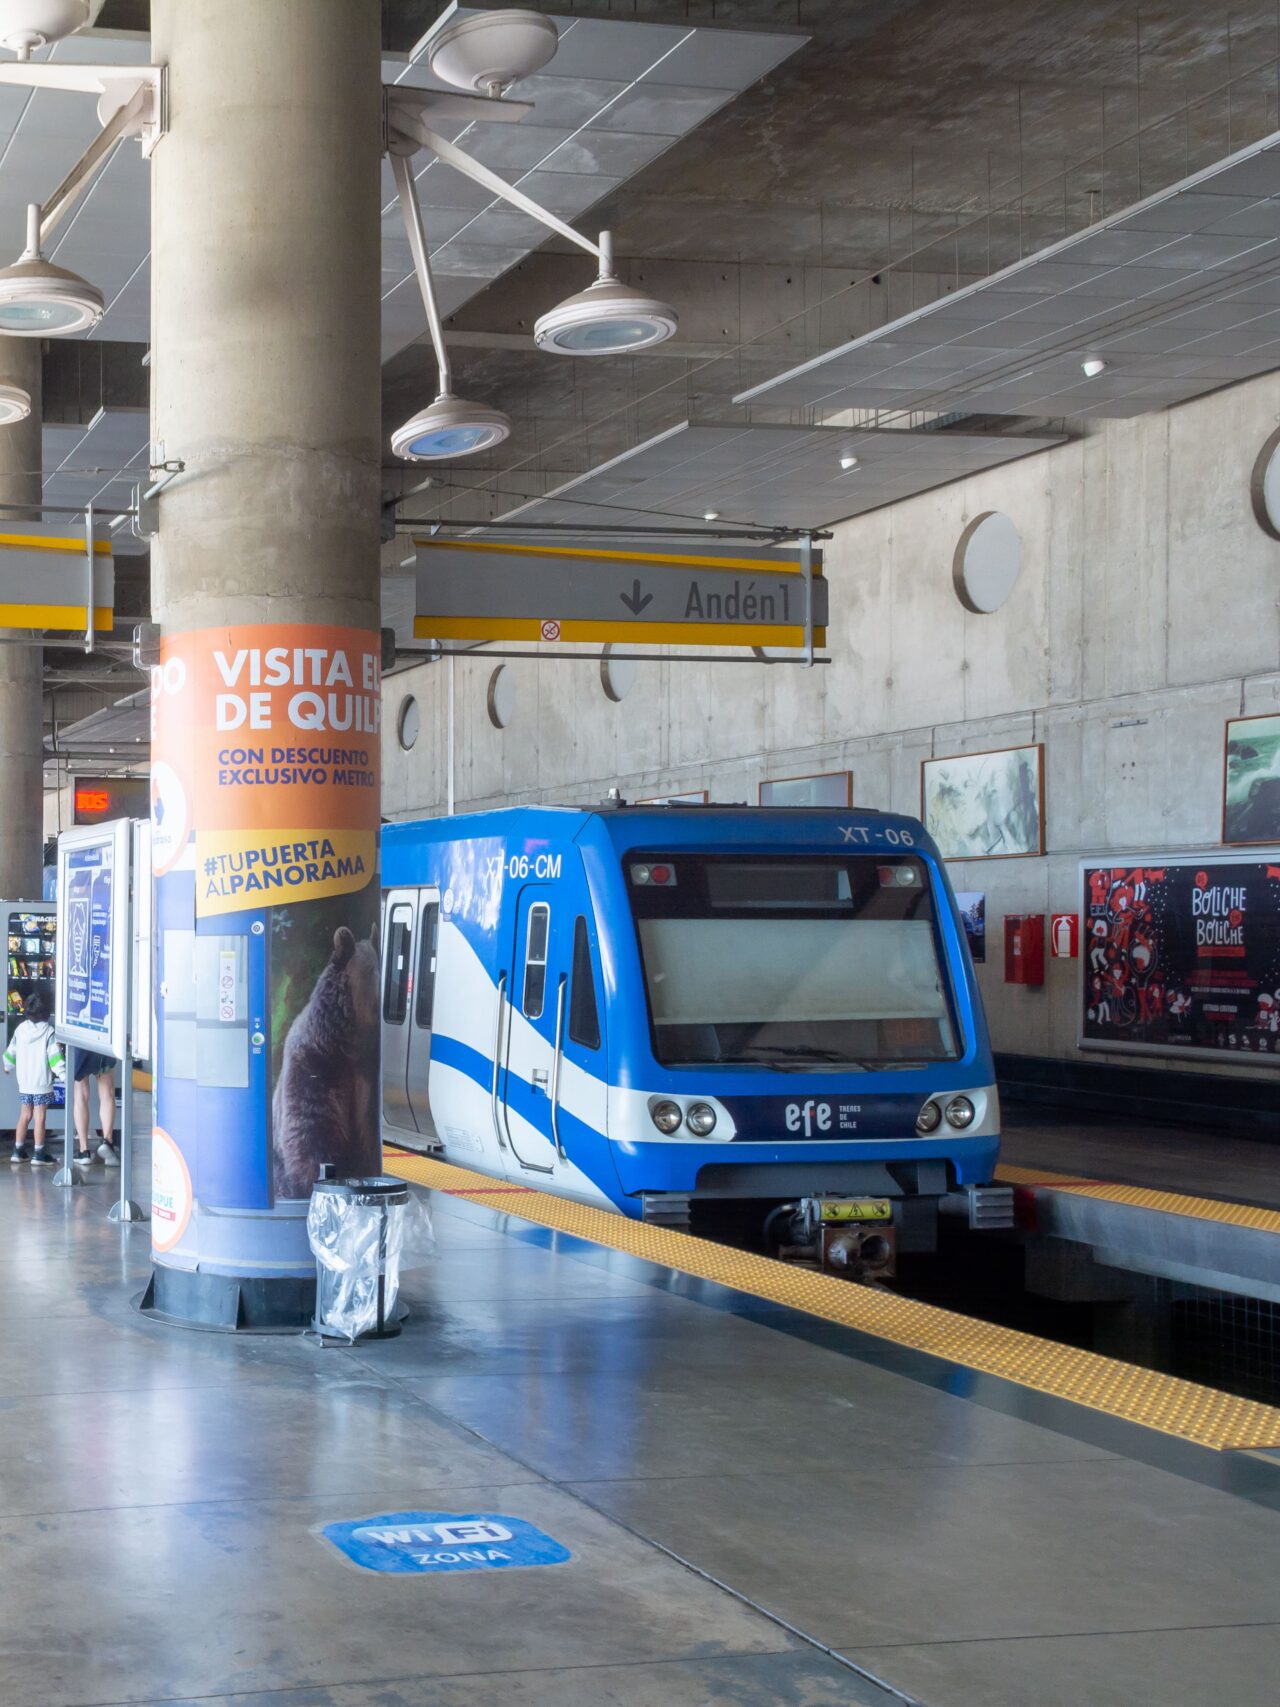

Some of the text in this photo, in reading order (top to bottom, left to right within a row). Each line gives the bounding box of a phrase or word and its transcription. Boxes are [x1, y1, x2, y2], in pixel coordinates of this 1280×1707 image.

[684, 581, 790, 621] Andén 1
[213, 648, 353, 688] VISITA
[216, 692, 271, 731] DE
[219, 748, 369, 766] CON DESCUENTO
[219, 768, 375, 787] EXCLUSIVO METRO
[838, 826, 914, 846] XT-06
[204, 838, 336, 876] #TUPUERTA
[486, 853, 562, 879] XT-06-CM
[785, 1100, 832, 1137] efe
[840, 1121, 857, 1129] CHILE
[411, 1550, 511, 1565] ZONA
